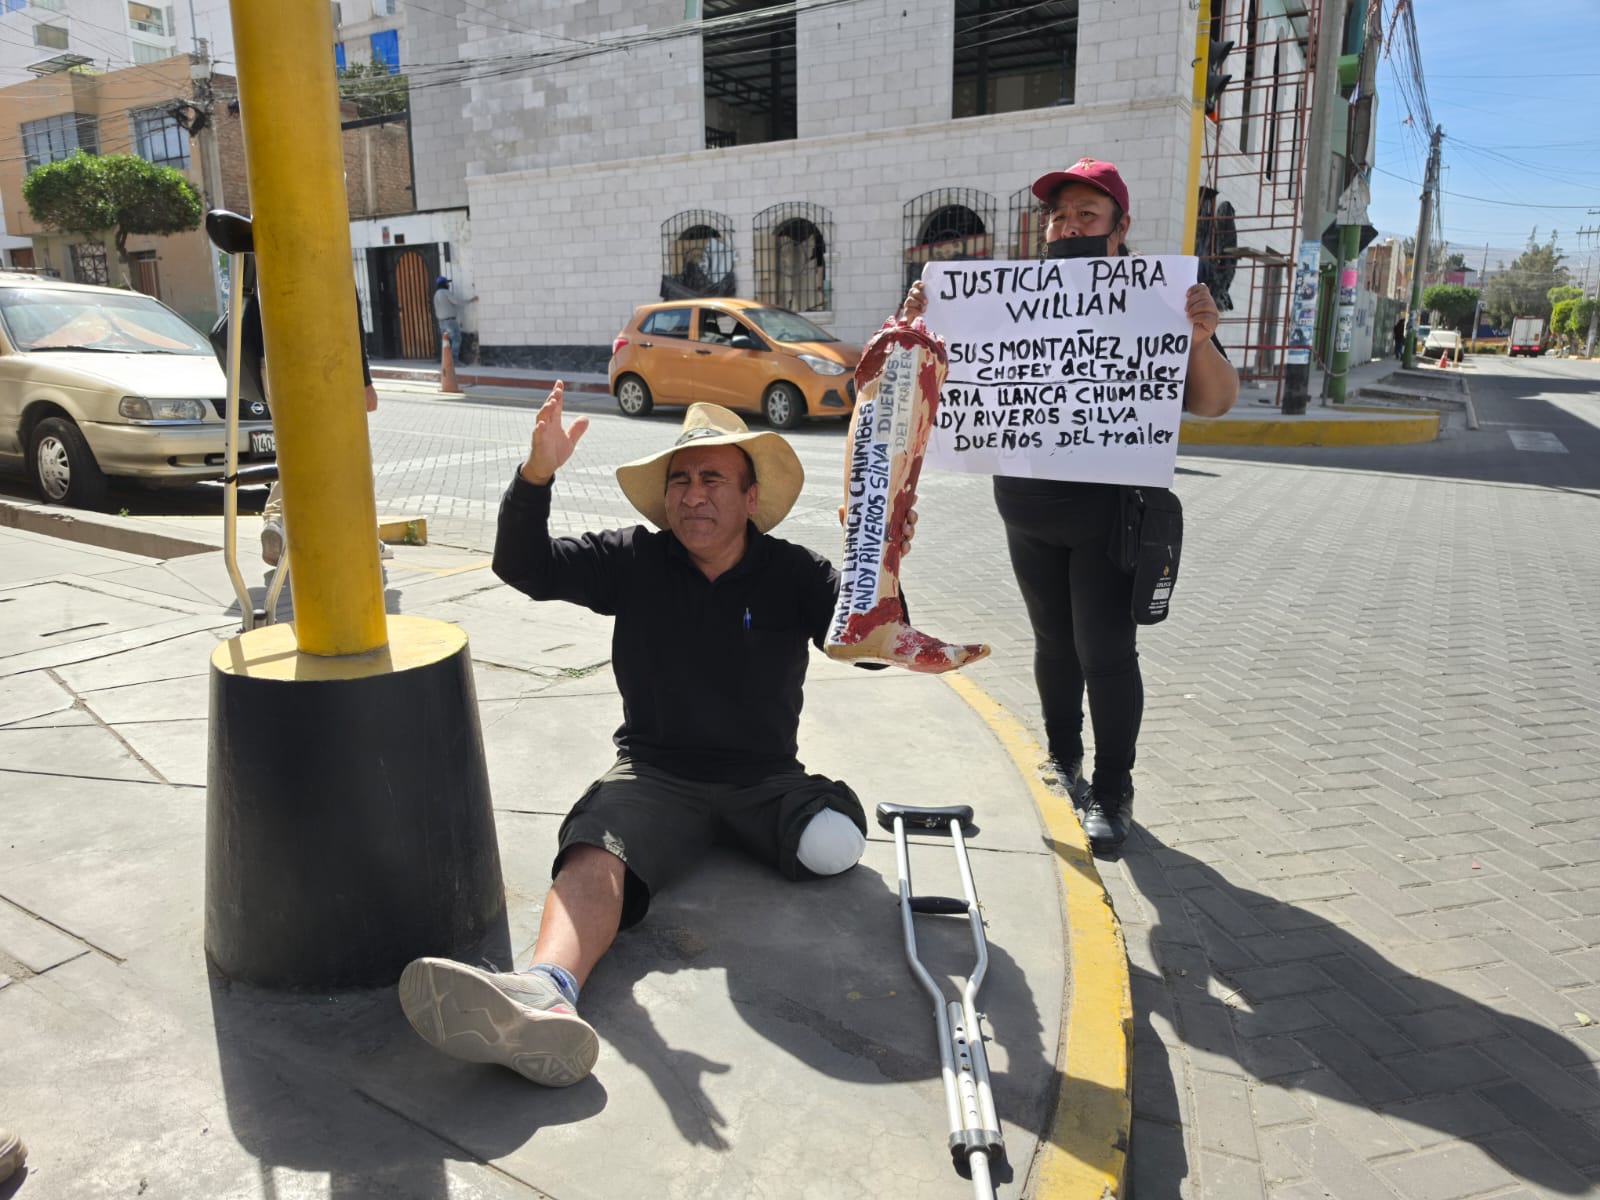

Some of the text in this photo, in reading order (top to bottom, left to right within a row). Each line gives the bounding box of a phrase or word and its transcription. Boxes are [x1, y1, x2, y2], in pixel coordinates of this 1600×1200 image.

[1087, 259, 1167, 292] PARA
[1006, 288, 1126, 323] WILLIAN
[949, 329, 1188, 369] SUS MONTAÑEZ JURO
[939, 383, 1178, 407] ARIA LLANCA CHUMBES
[895, 421, 909, 449] DEL
[933, 406, 1138, 433] DY RIVEROS SILVA
[849, 402, 874, 498] CHUMBES
[953, 422, 1174, 452] DUEÑOS DEL trailer
[854, 567, 877, 611] ANDY
